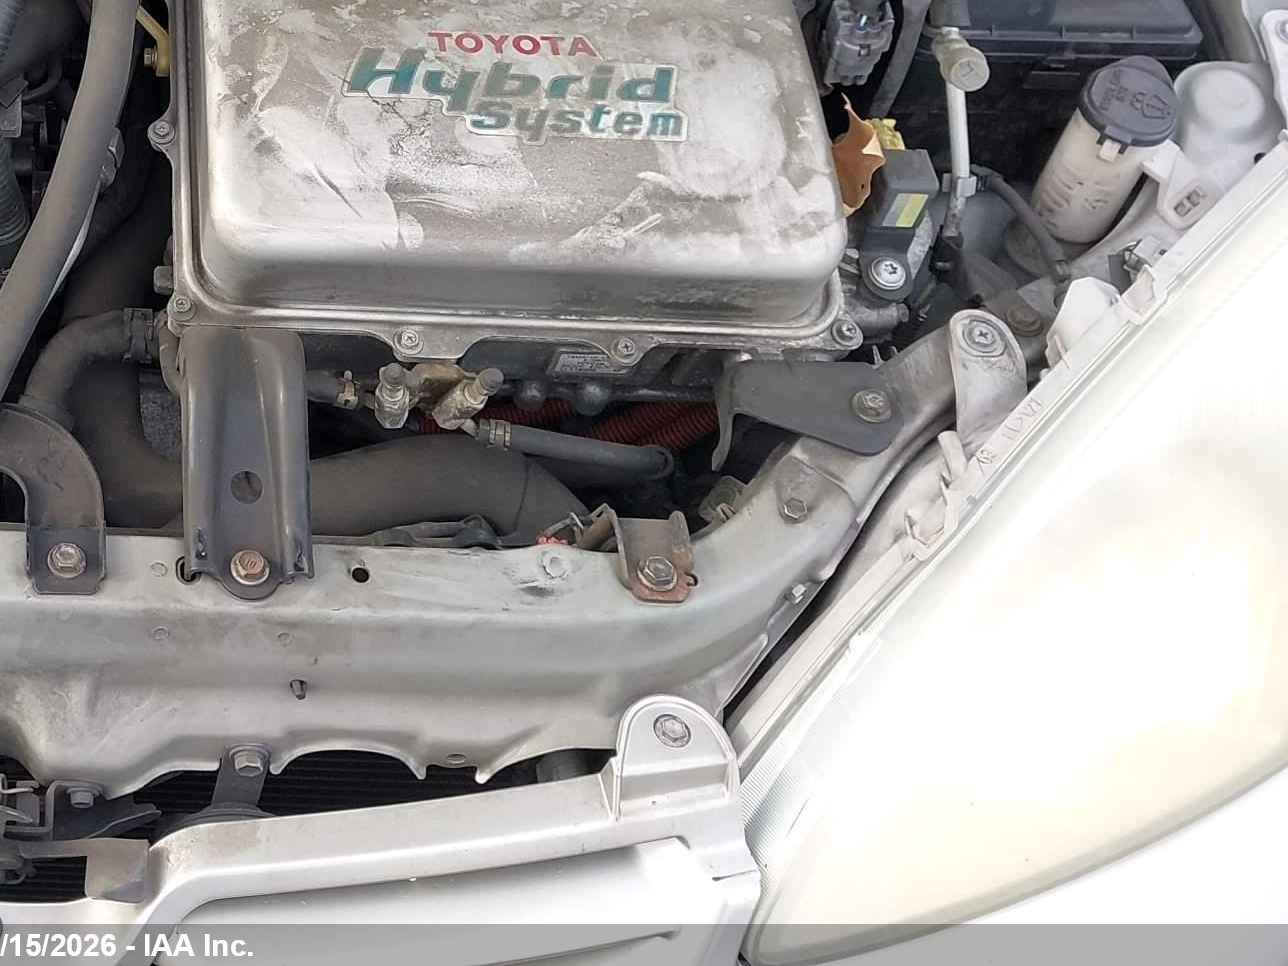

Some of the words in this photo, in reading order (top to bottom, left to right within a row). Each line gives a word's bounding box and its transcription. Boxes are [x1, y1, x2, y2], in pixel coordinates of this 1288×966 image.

[429, 33, 596, 57] TOYOTA
[346, 47, 675, 112] Hybrid
[471, 103, 683, 142] System
